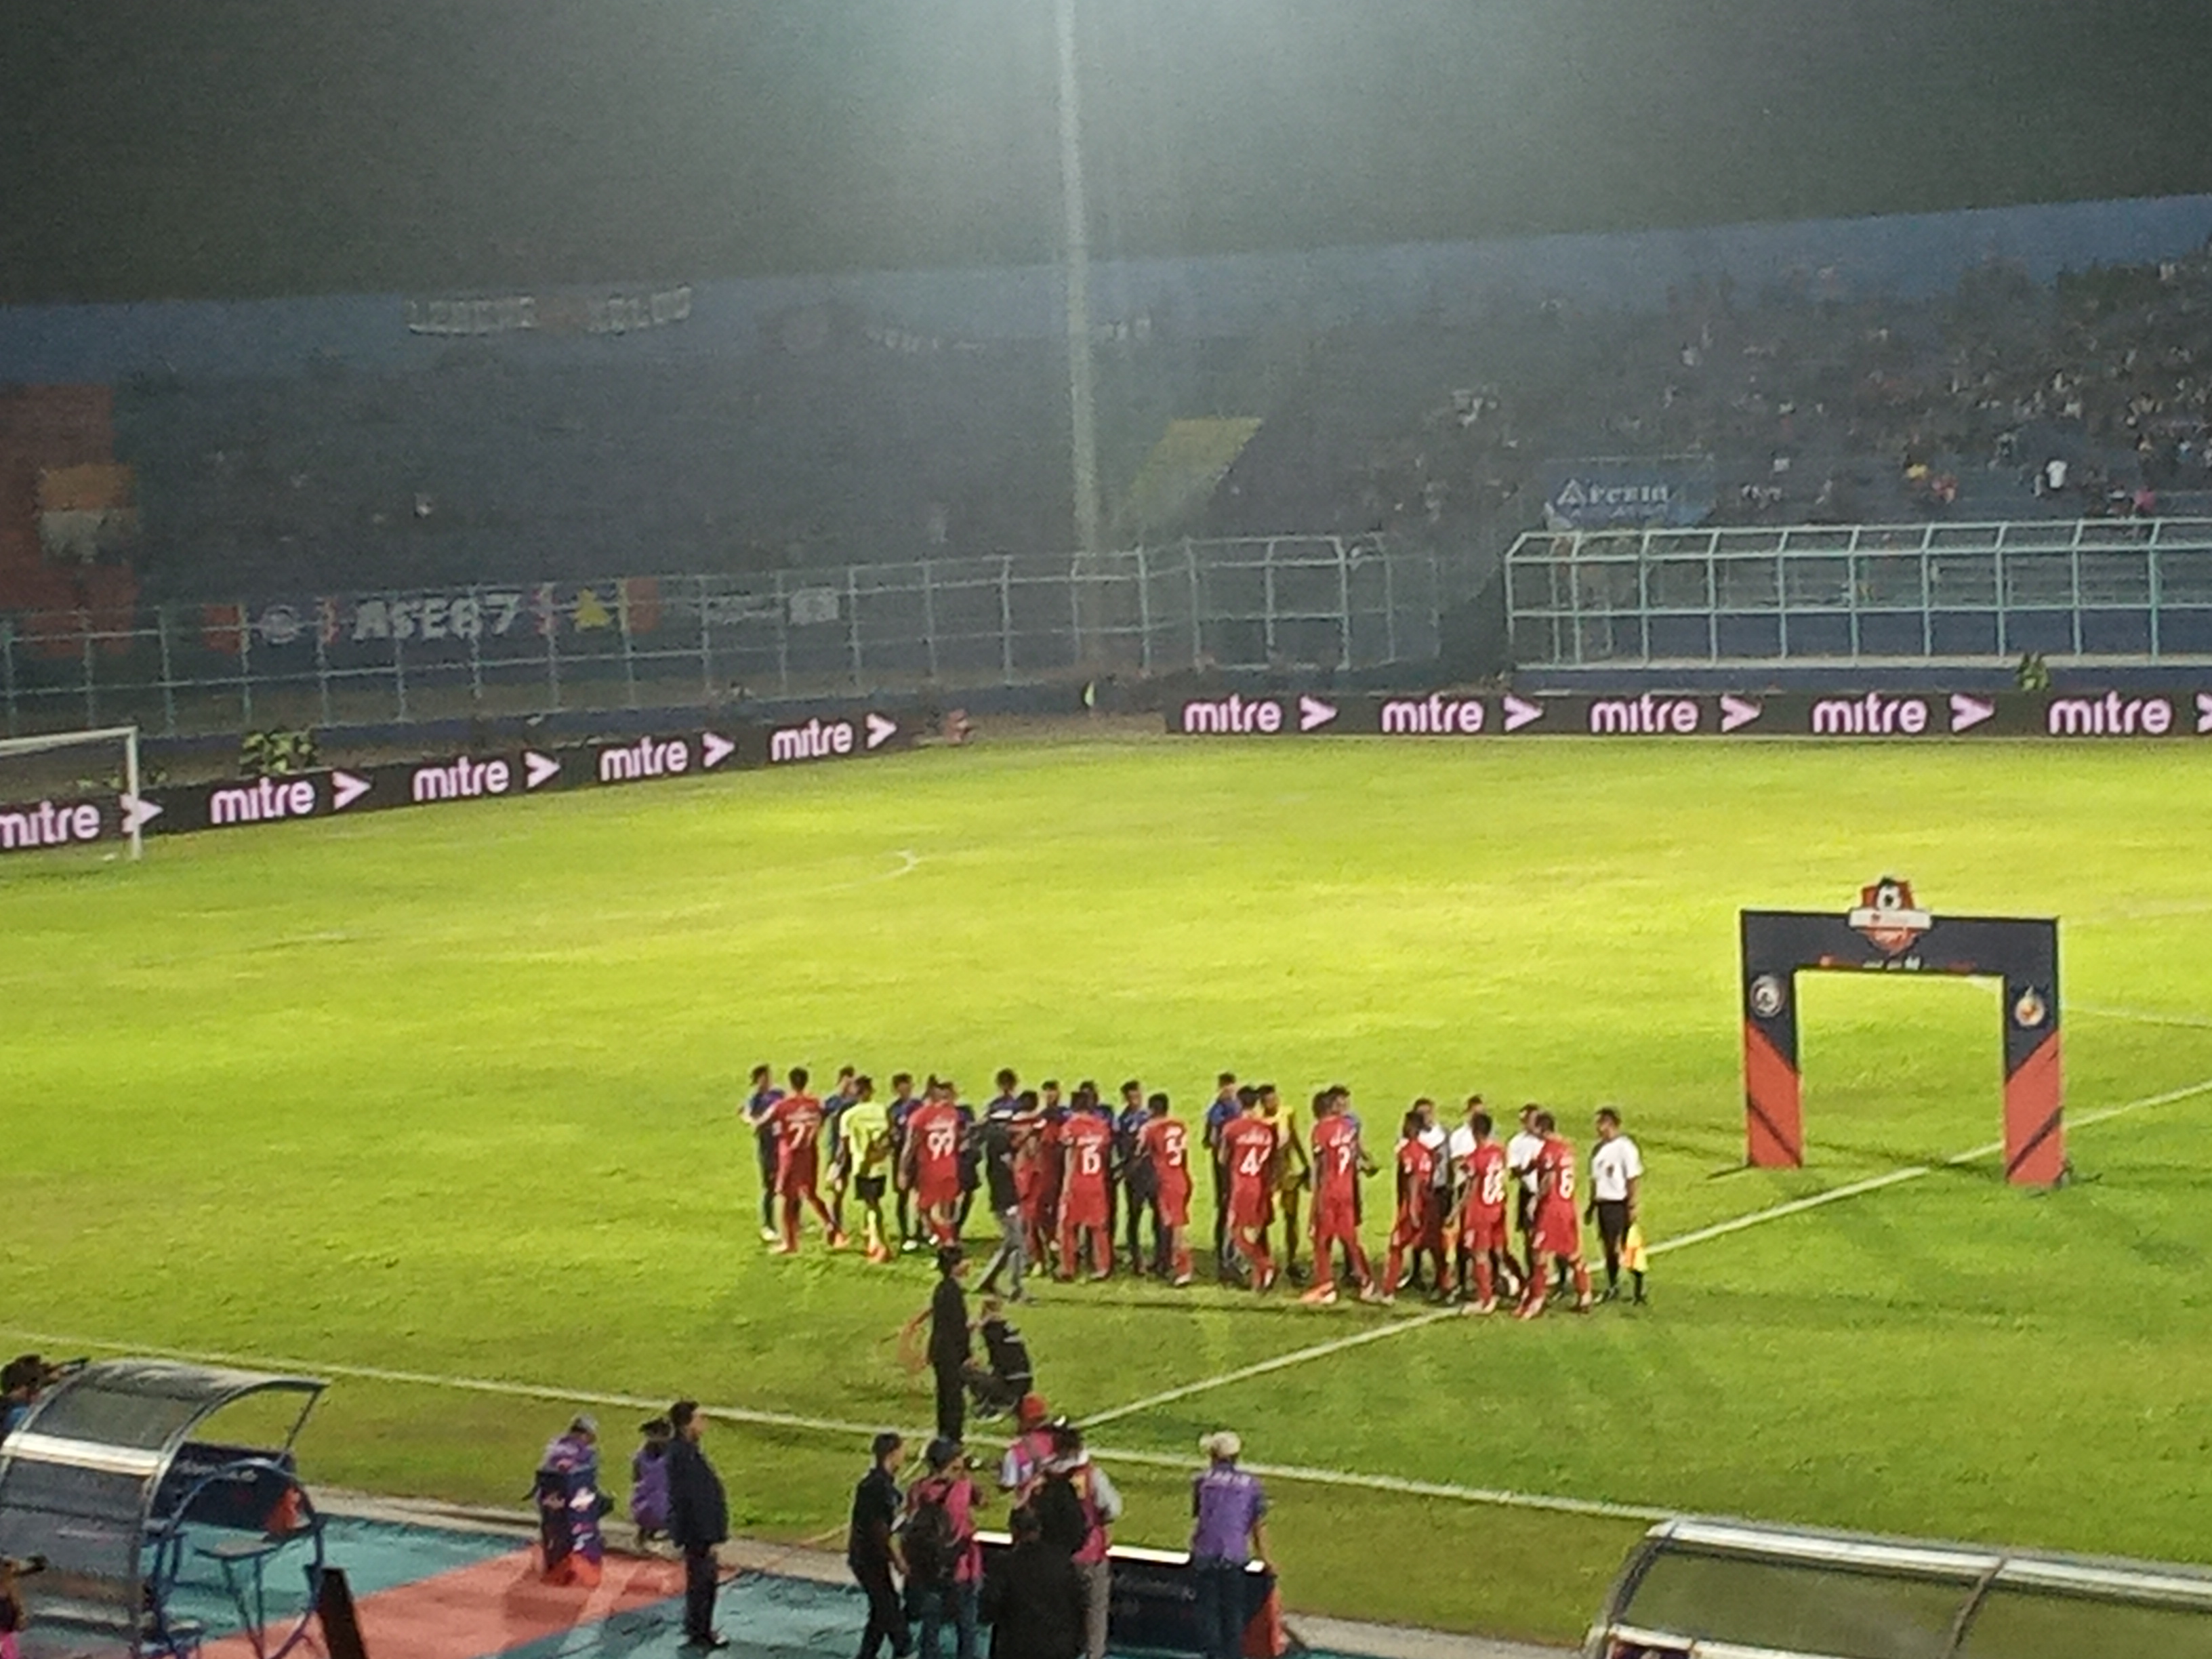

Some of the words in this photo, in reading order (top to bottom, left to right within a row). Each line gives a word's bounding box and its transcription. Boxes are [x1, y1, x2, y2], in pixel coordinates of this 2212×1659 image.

[1184, 693, 1282, 733] mitre
[1381, 693, 1484, 733] mitre
[1591, 689, 1699, 733] mitre
[1812, 691, 1927, 733] mitre
[2049, 690, 2171, 735] mitre
[600, 736, 689, 781] mitre
[771, 718, 853, 762] mitre
[211, 777, 316, 824] mitre
[413, 756, 510, 801] mitre
[927, 1129, 956, 1162] 99
